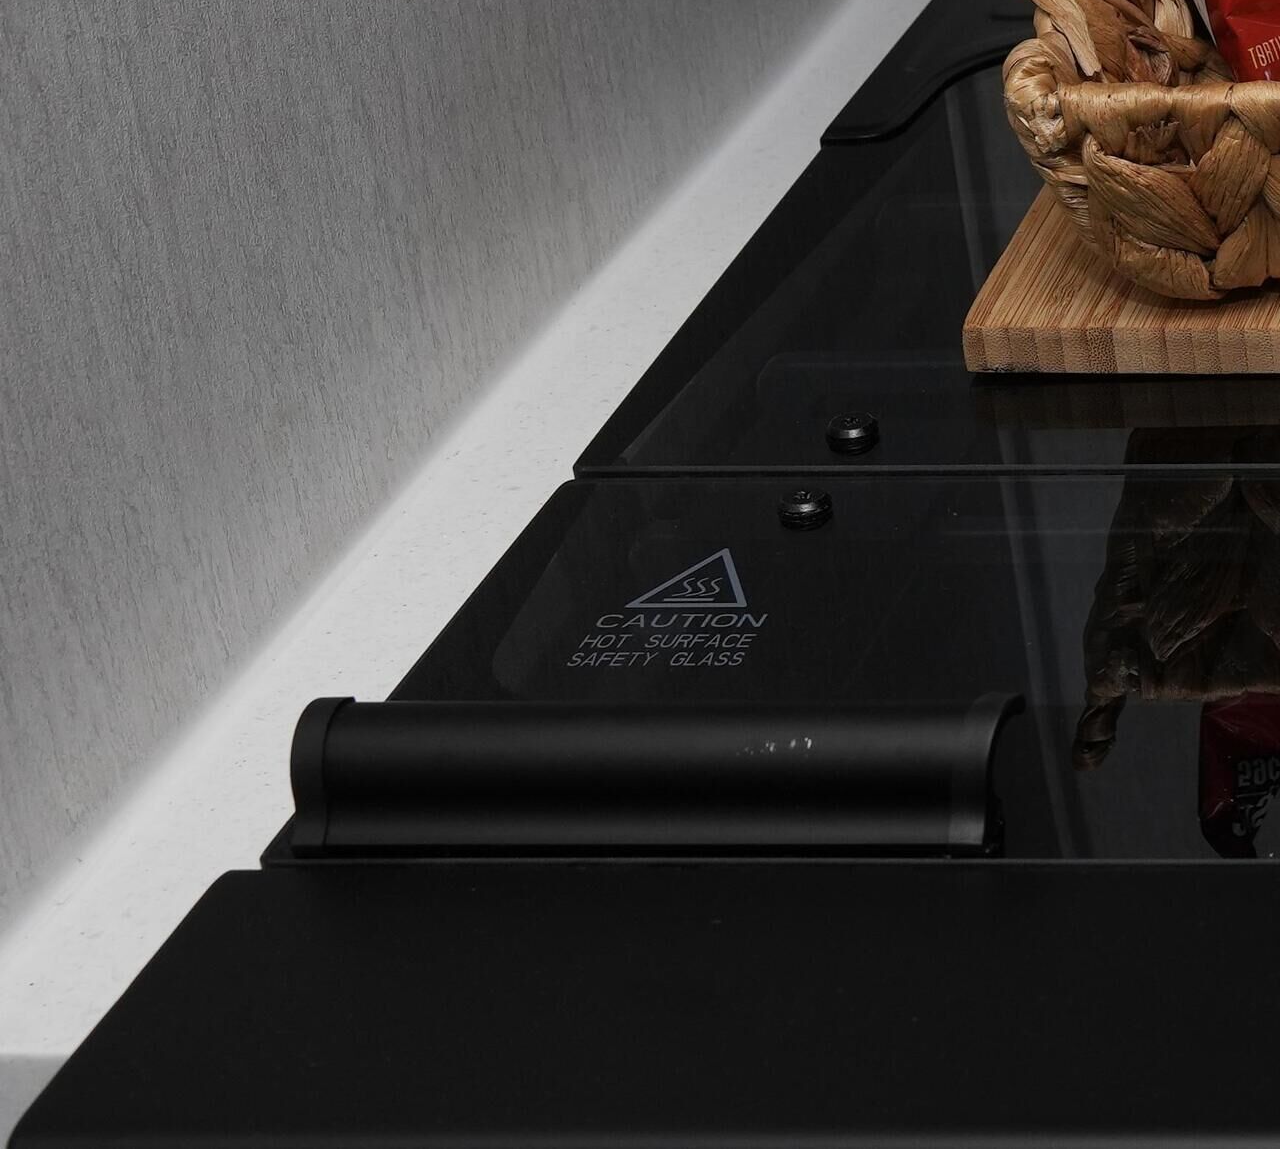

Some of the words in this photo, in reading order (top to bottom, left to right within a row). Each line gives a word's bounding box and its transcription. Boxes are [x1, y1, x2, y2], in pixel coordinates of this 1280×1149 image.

[595, 614, 768, 628] CAUTION
[578, 634, 633, 649] HOT
[644, 633, 758, 649] SURFACE
[567, 652, 658, 667] SAFETY
[669, 652, 745, 667] GLASS
